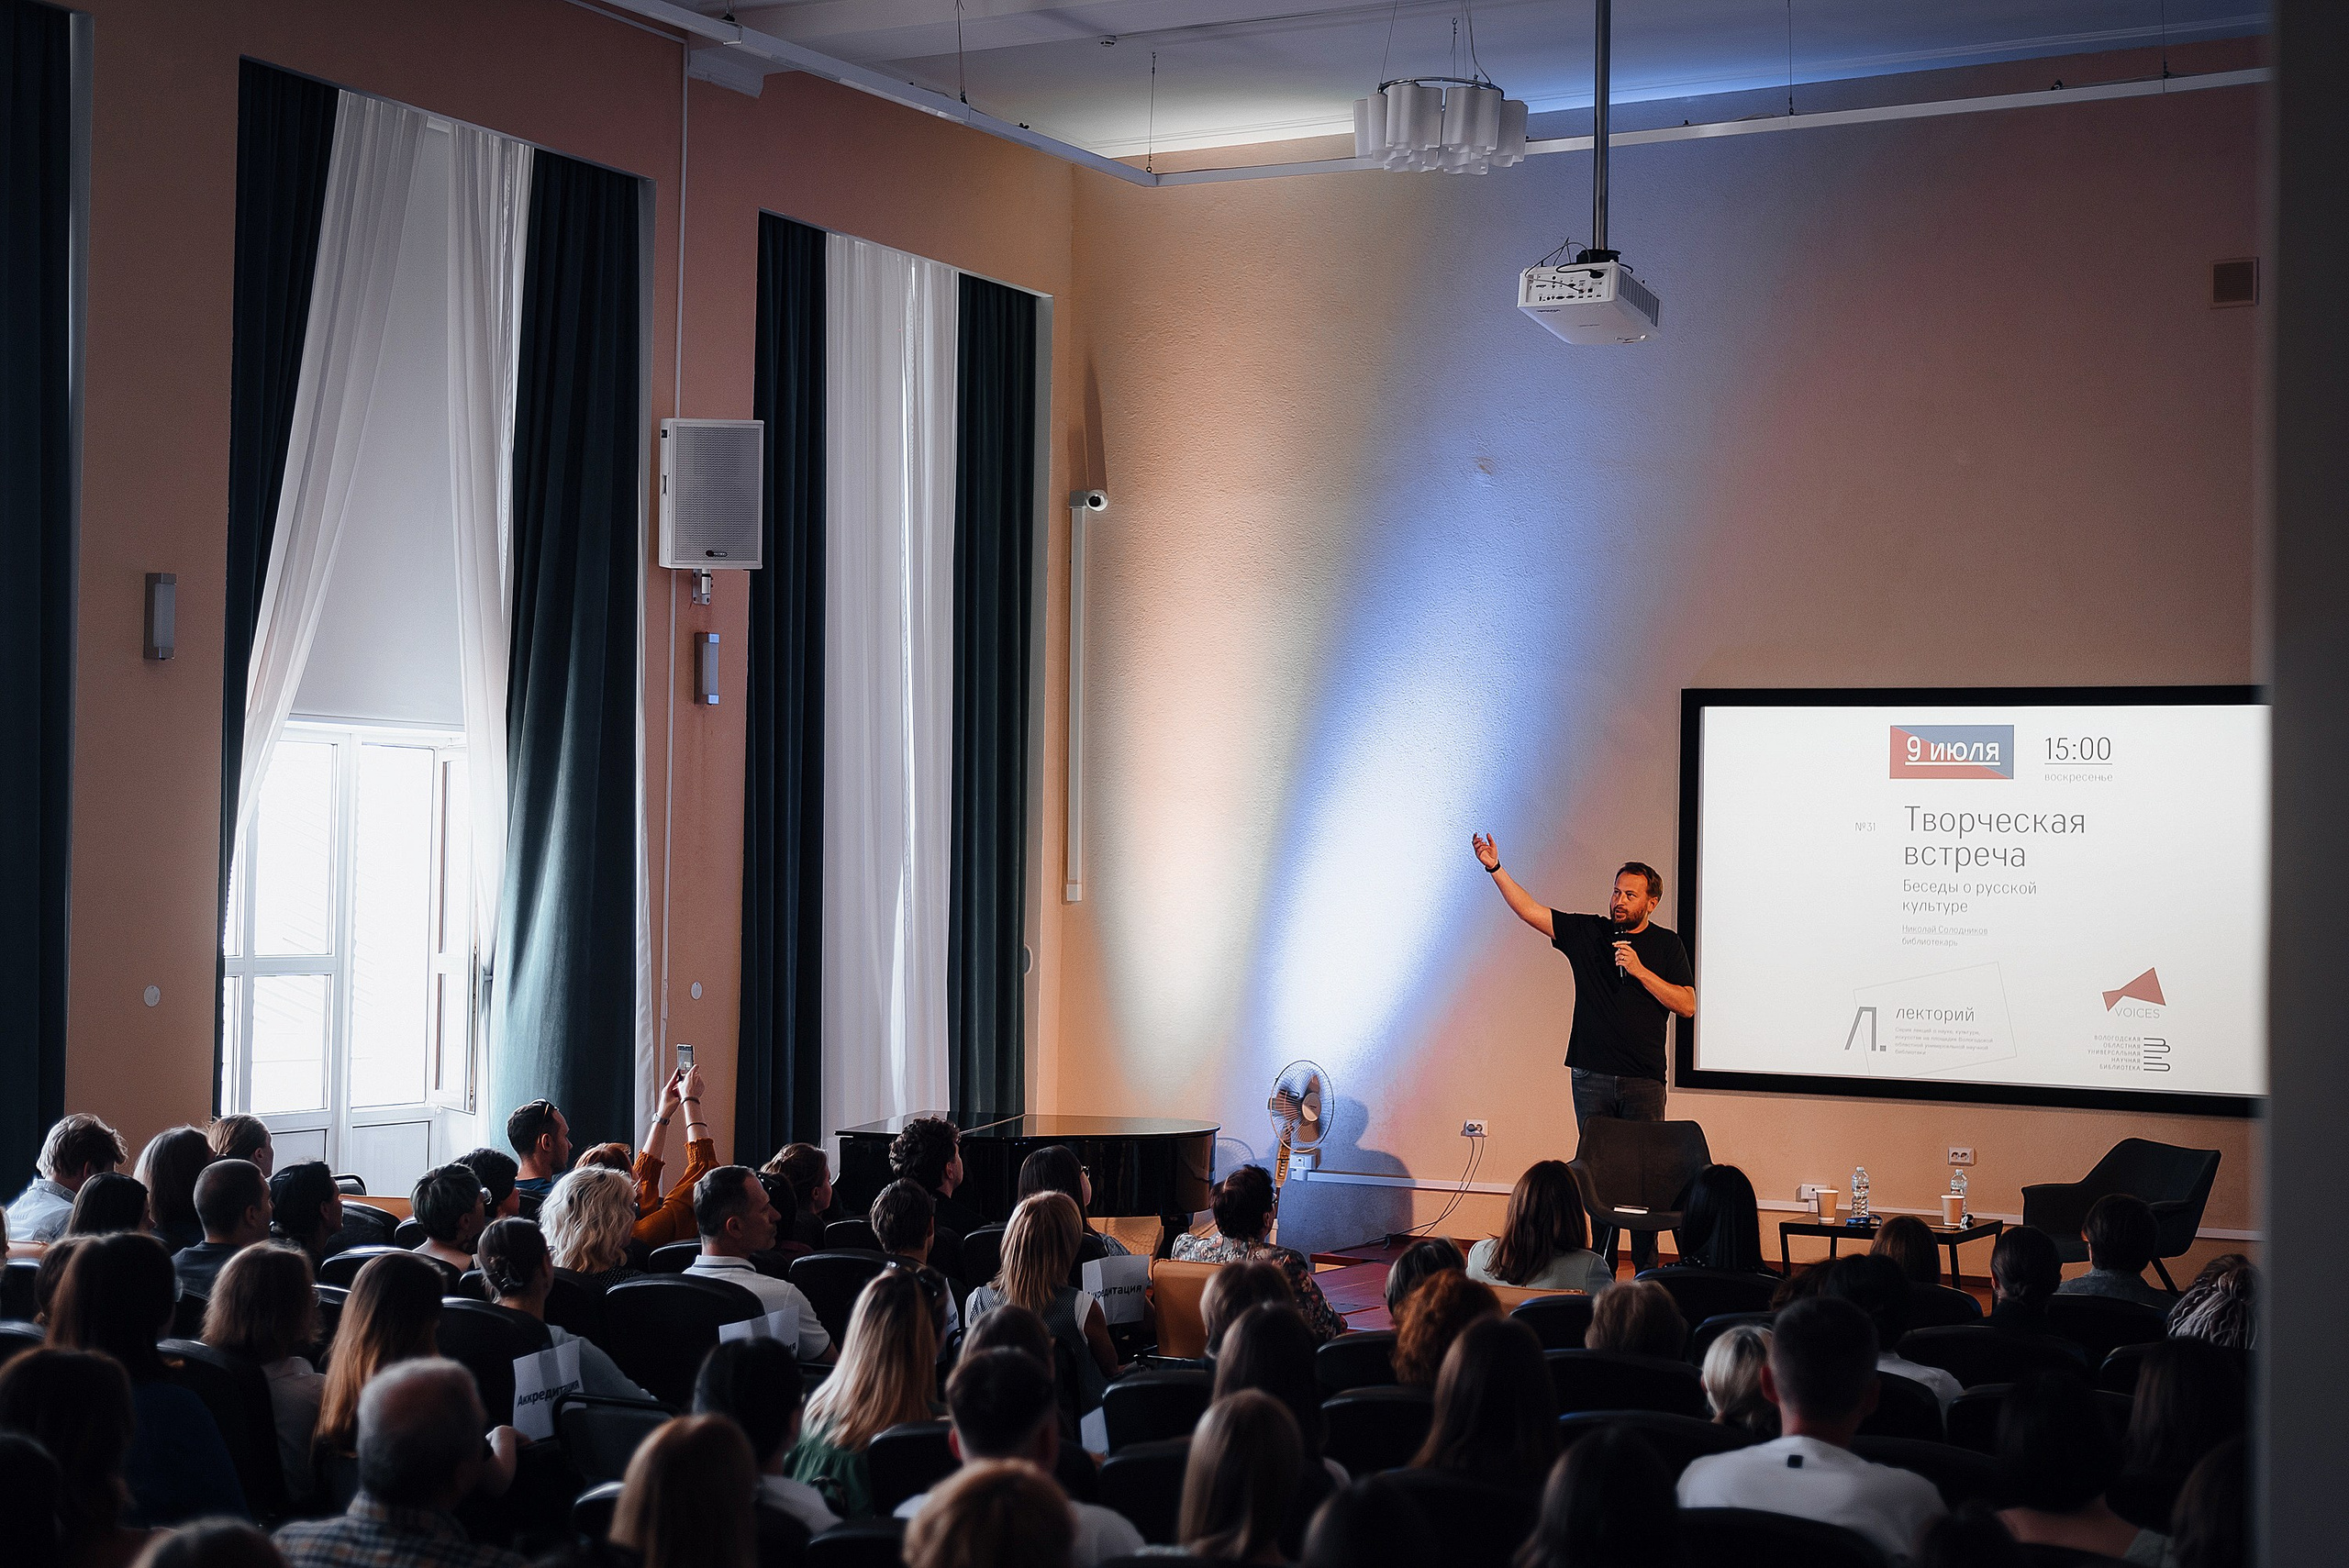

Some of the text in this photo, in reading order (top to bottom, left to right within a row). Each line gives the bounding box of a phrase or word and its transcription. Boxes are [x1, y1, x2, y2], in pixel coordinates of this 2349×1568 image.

[1906, 735, 2000, 762] 9 июля
[2043, 736, 2112, 762] 15:00
[2043, 773, 2113, 784] воскресенье
[1854, 821, 1876, 832] №31
[1904, 805, 2086, 839] Творческая
[1904, 845, 2026, 873] встреча
[1903, 878, 2038, 897] Беседы о русской
[1902, 900, 1969, 916] культуре
[1901, 924, 1937, 934] Николай
[1895, 1006, 1975, 1024] лекторий
[2114, 1006, 2161, 1019] VOICES
[1086, 1284, 1142, 1300] кредитация
